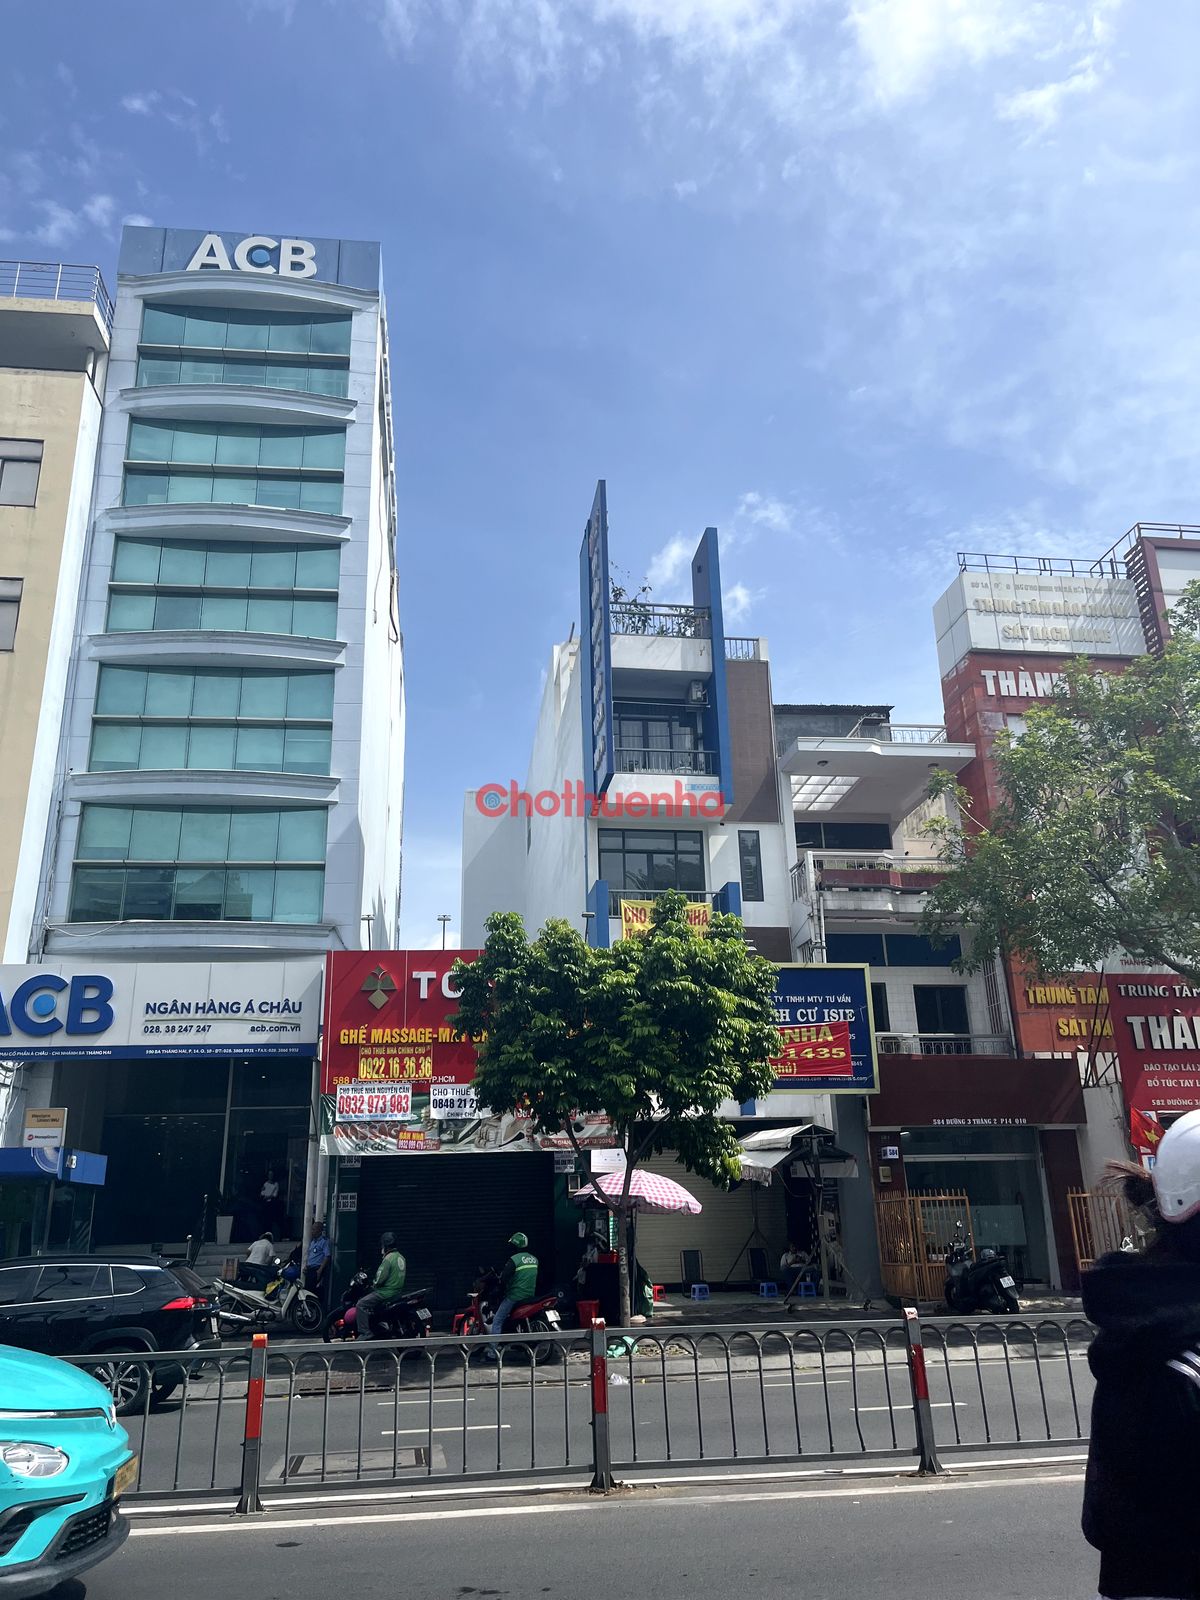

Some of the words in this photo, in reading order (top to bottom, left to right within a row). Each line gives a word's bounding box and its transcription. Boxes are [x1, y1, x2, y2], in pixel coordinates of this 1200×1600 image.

[186, 234, 318, 279] ACB
[975, 598, 1020, 614] TRUNG
[1022, 598, 1050, 615] TÂM
[1003, 623, 1029, 640] SÁT
[1031, 626, 1070, 644] HẠCH
[624, 906, 647, 924] CHO
[785, 995, 805, 1003] TNHH
[836, 993, 851, 1003] VẤN
[1026, 986, 1076, 1004] TRUNG
[1078, 984, 1109, 1004] TÂM
[1118, 984, 1169, 997] TRUNG
[0, 974, 114, 1036] CB
[145, 1000, 191, 1014] NGÂN
[195, 999, 241, 1014] HÀNG
[244, 999, 255, 1013] Á
[257, 998, 302, 1013] CHÂU
[796, 1006, 818, 1022] CƯ
[823, 1008, 856, 1022] ISIE
[144, 1025, 162, 1033] 028.
[165, 1025, 175, 1033] 38
[178, 1025, 193, 1033] 247
[196, 1025, 211, 1033] 247
[250, 1024, 301, 1032] acb.com.vn
[340, 1024, 368, 1045] GHẾ
[1058, 1015, 1088, 1037] SÁT
[1091, 1019, 1114, 1039] HẠ
[360, 1056, 432, 1079] 0922.16.36.36
[1163, 1063, 1179, 1073] TẠO
[333, 1076, 350, 1084] 588
[1161, 1077, 1178, 1087] TÚC
[1180, 1079, 1194, 1087] TAY
[339, 1087, 350, 1095] CHO
[433, 1089, 448, 1097] CHO
[338, 1096, 365, 1114] 0932
[367, 1095, 387, 1114] 973
[390, 1095, 409, 1113] 983
[433, 1099, 454, 1109] 0848
[457, 1098, 467, 1108] 21
